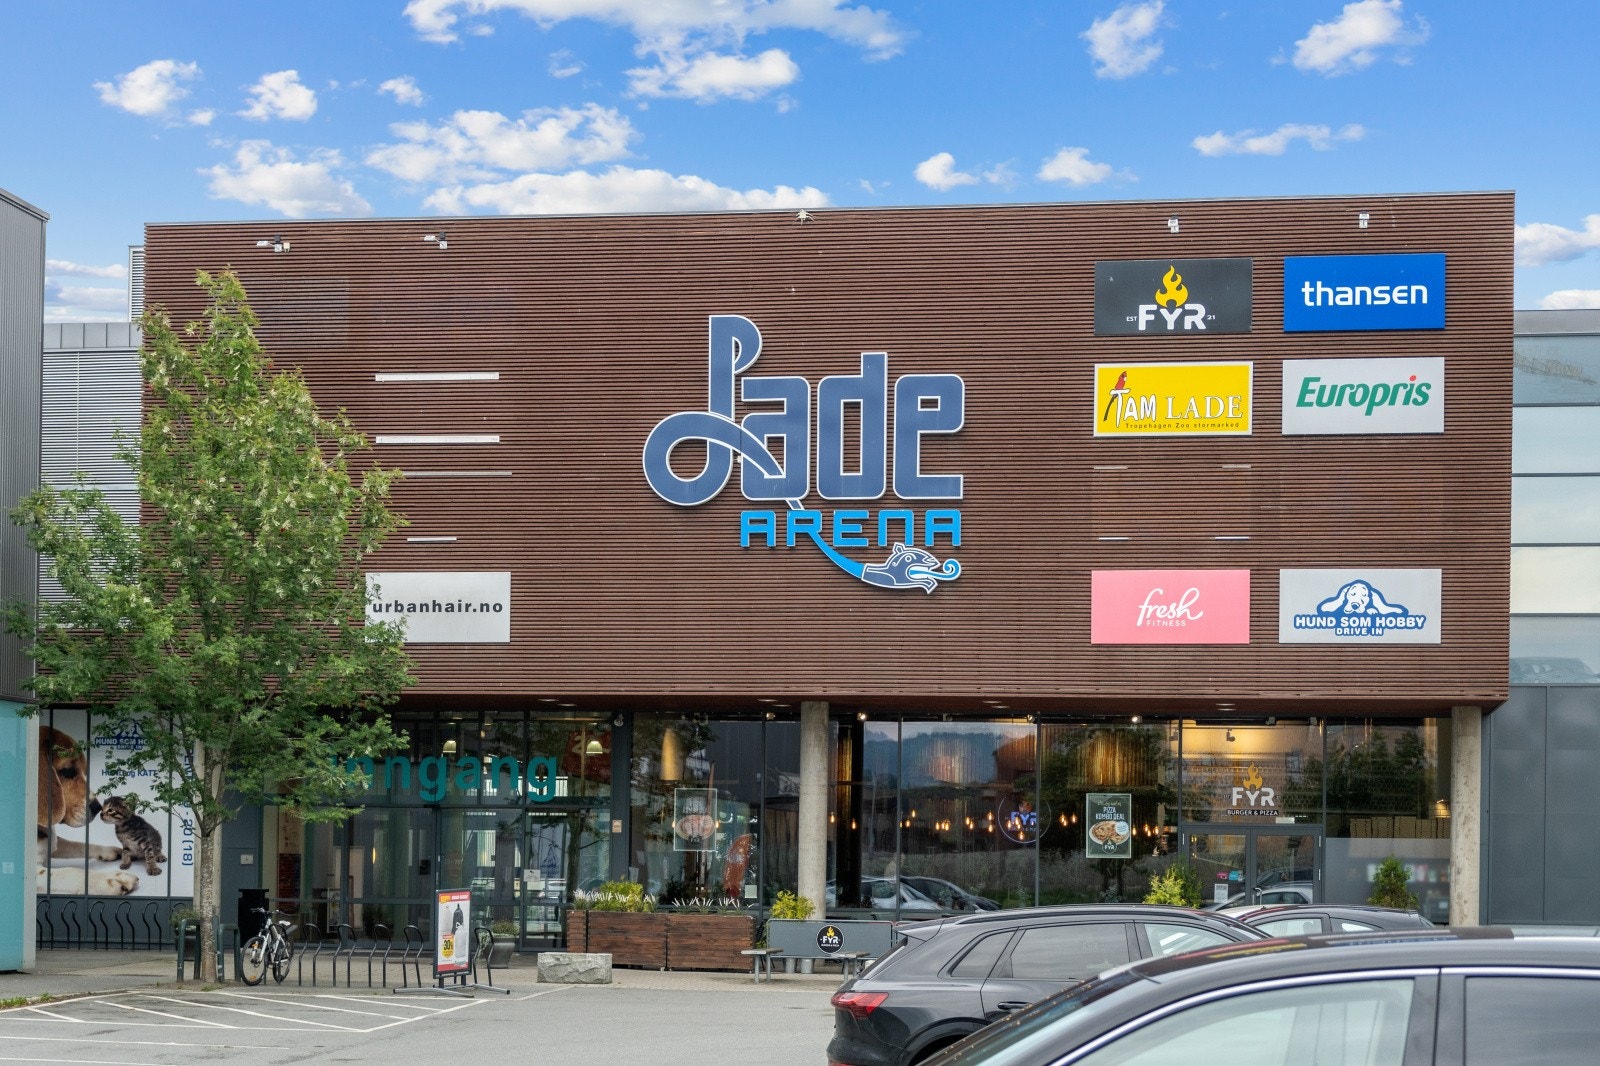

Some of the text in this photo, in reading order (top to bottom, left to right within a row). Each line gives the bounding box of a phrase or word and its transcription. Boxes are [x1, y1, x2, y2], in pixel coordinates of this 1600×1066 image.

[1301, 280, 1428, 307] thansen
[1138, 303, 1207, 331] FYR
[1109, 388, 1243, 428] TAM LADE
[1296, 375, 1432, 416] Europris
[740, 510, 962, 547] ARENA
[372, 600, 503, 613] urbanhair.no
[1137, 587, 1204, 627] fresh
[1295, 616, 1425, 628] HUND SOM HOBBY
[1336, 627, 1383, 635] DRIVE IN
[329, 754, 557, 802] nngang
[1232, 787, 1275, 807] FYR
[182, 840, 194, 866] (18)
[822, 935, 839, 944] FYR
